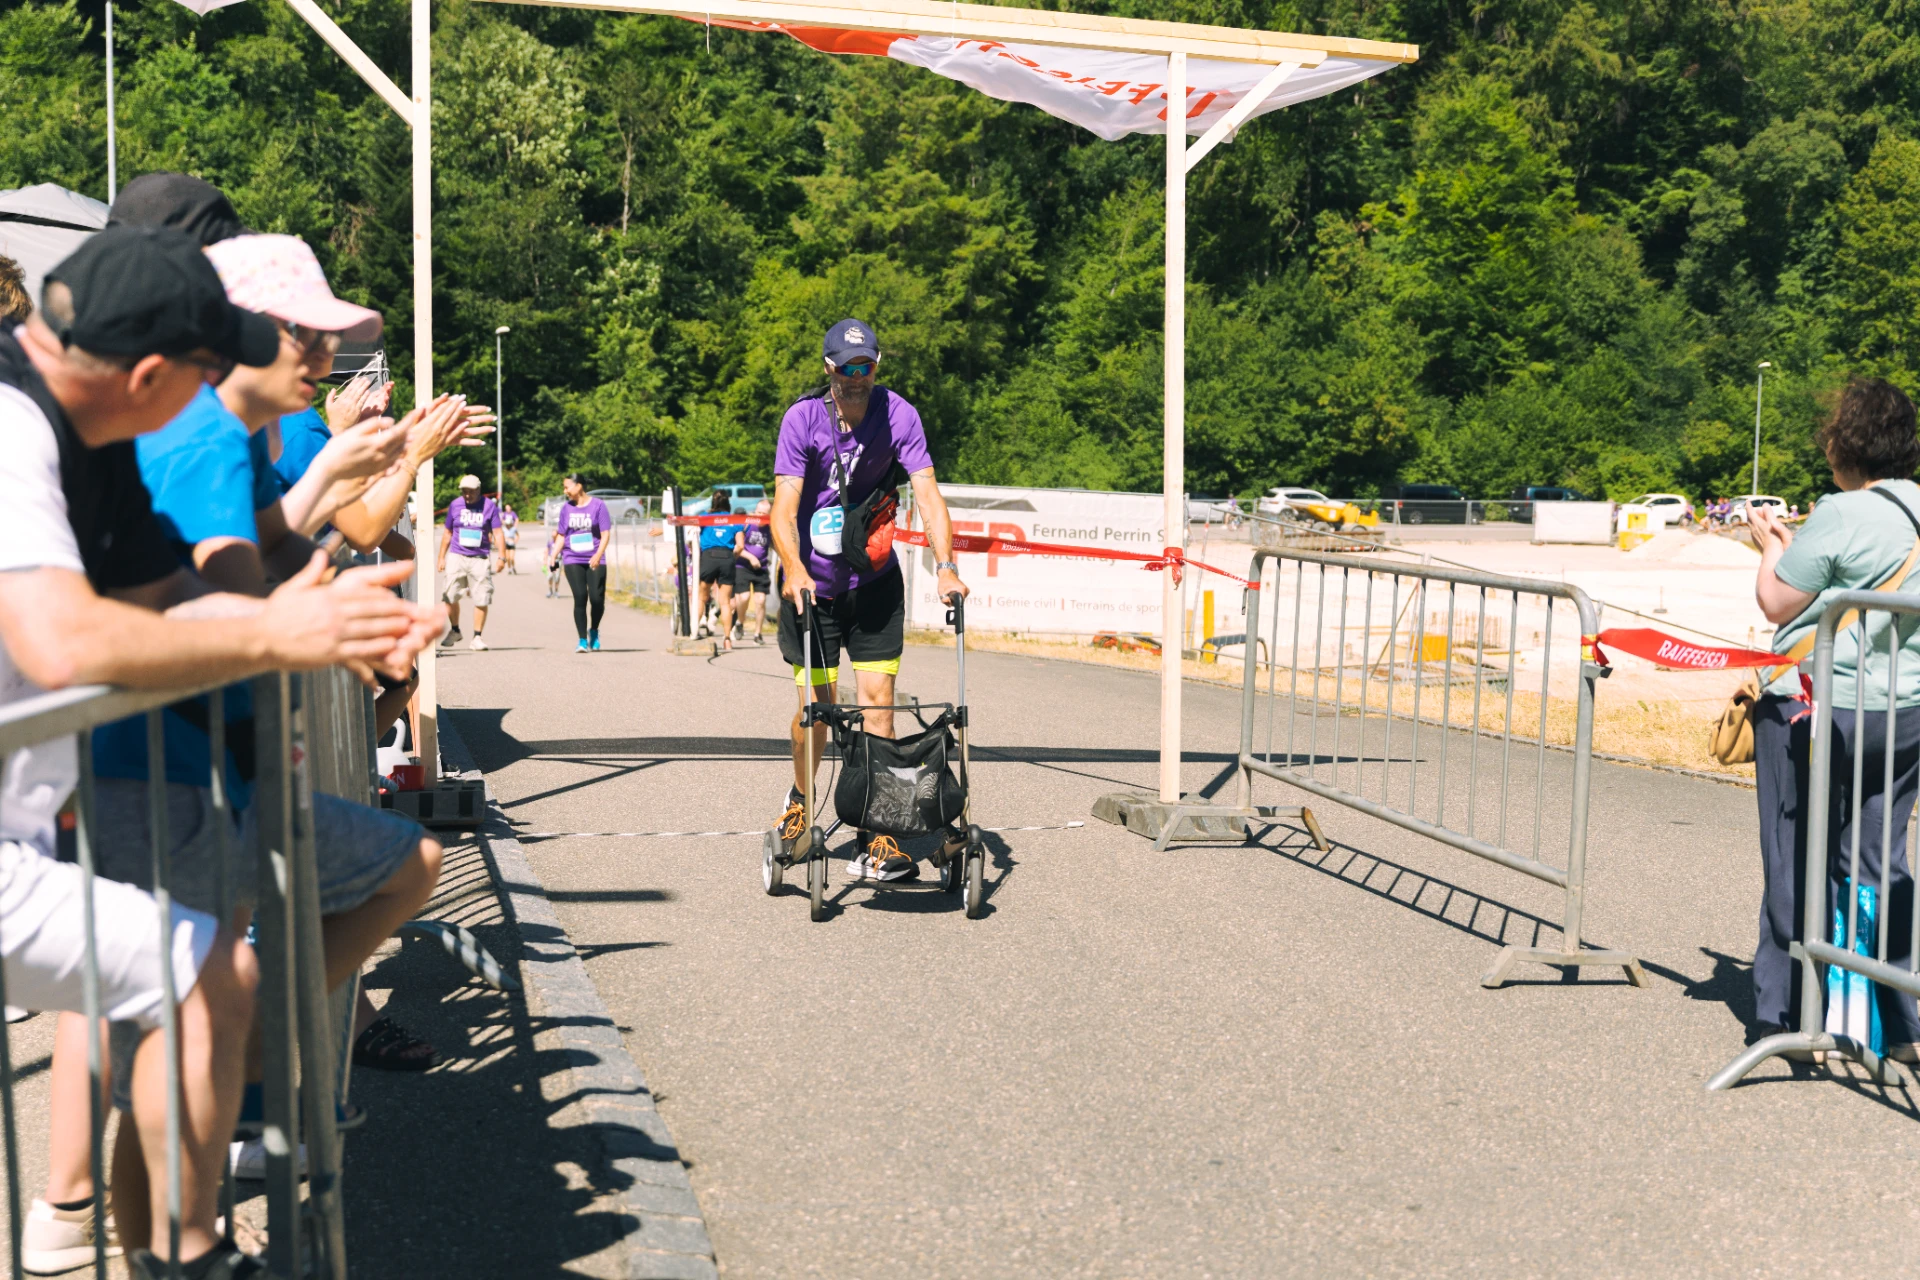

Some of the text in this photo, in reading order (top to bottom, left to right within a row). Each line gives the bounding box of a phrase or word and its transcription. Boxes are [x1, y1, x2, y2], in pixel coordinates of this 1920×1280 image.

[1032, 523, 1098, 540] Fernand
[1104, 527, 1151, 542] Perrin
[996, 596, 1031, 608] Génie
[1034, 597, 1056, 608] civil
[1070, 599, 1115, 611] Terrains
[1118, 601, 1132, 612] de
[1136, 603, 1164, 614] spor
[1656, 639, 1729, 667] RAIFFEISEN
